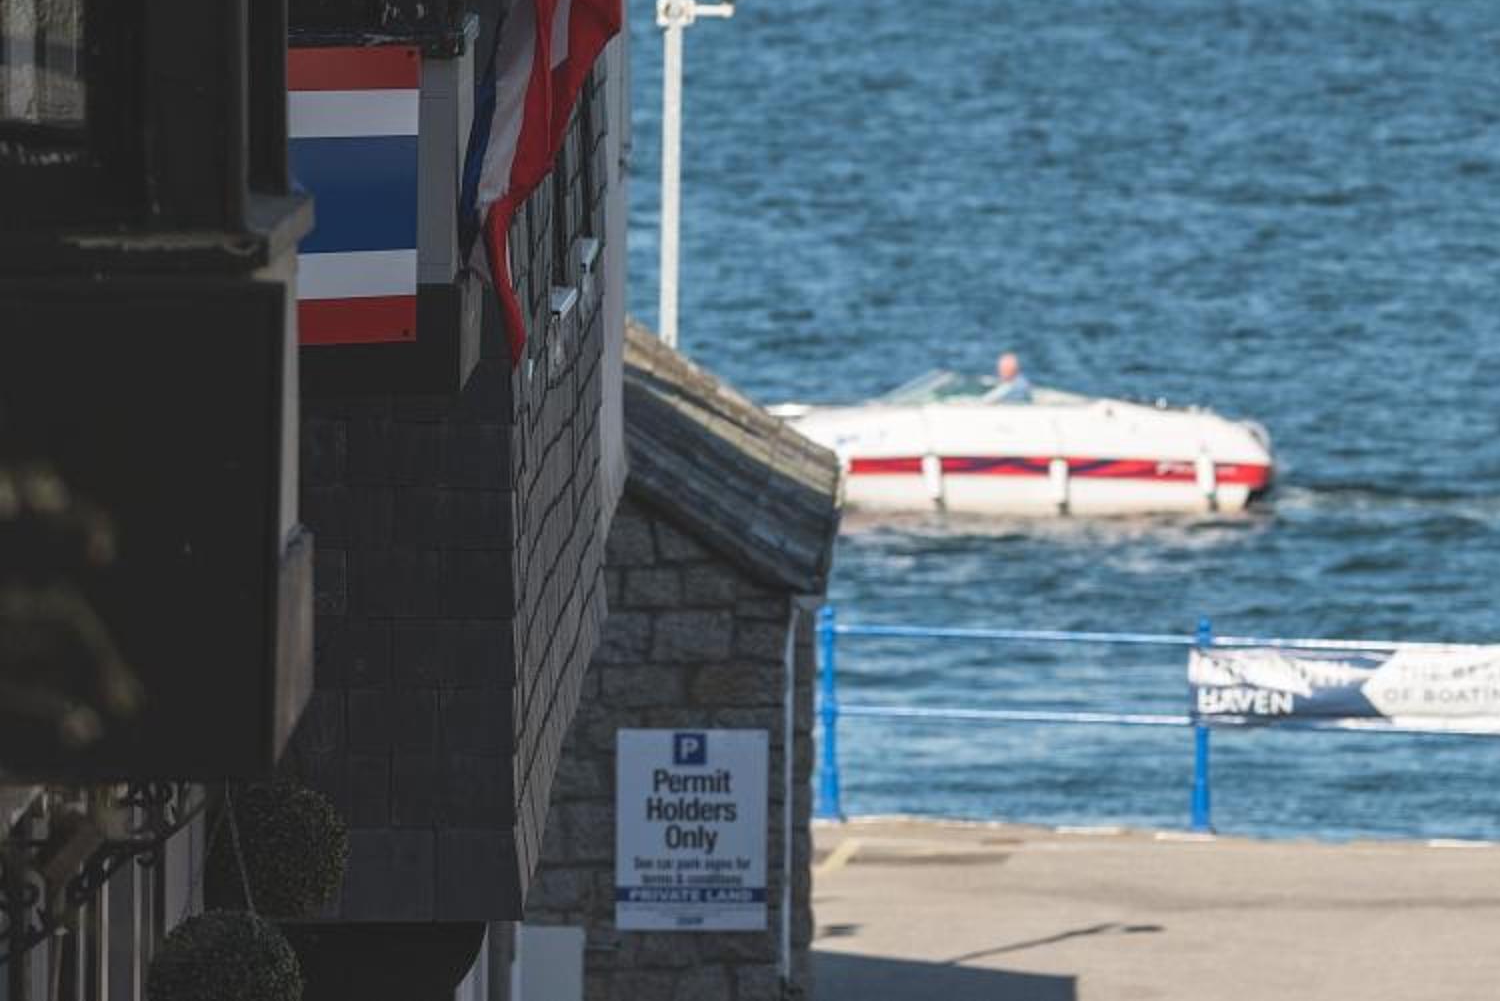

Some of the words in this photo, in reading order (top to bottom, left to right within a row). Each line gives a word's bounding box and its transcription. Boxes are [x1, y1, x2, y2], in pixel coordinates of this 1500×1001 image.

[680, 738, 699, 760] P
[653, 769, 731, 794] Permit
[646, 797, 738, 822] Holders
[665, 824, 718, 854] Only
[629, 888, 692, 901] PRIVATE
[702, 888, 753, 901] LAND
